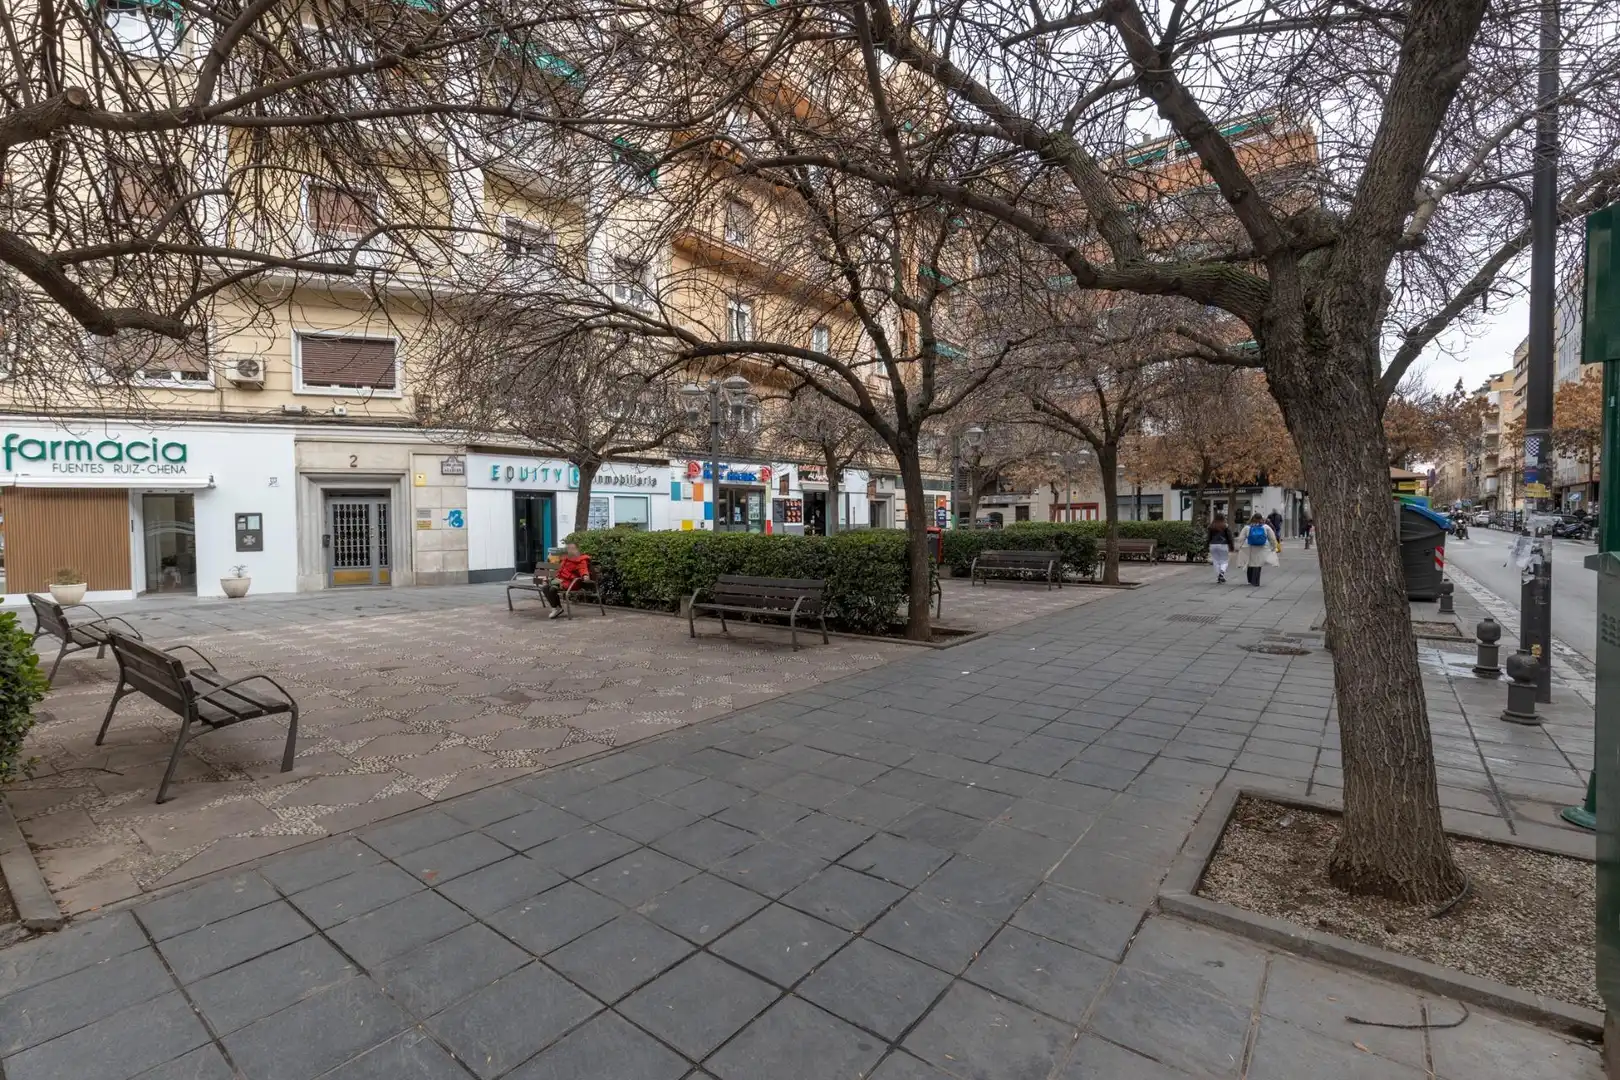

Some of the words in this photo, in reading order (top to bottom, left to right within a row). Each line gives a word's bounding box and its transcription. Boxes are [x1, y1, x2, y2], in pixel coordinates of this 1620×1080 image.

[2, 433, 187, 471] farmacia
[52, 463, 104, 474] FUENTES
[113, 463, 187, 475] RUIZ-CHENA
[349, 454, 358, 468] 2
[491, 464, 562, 483] EQUITY
